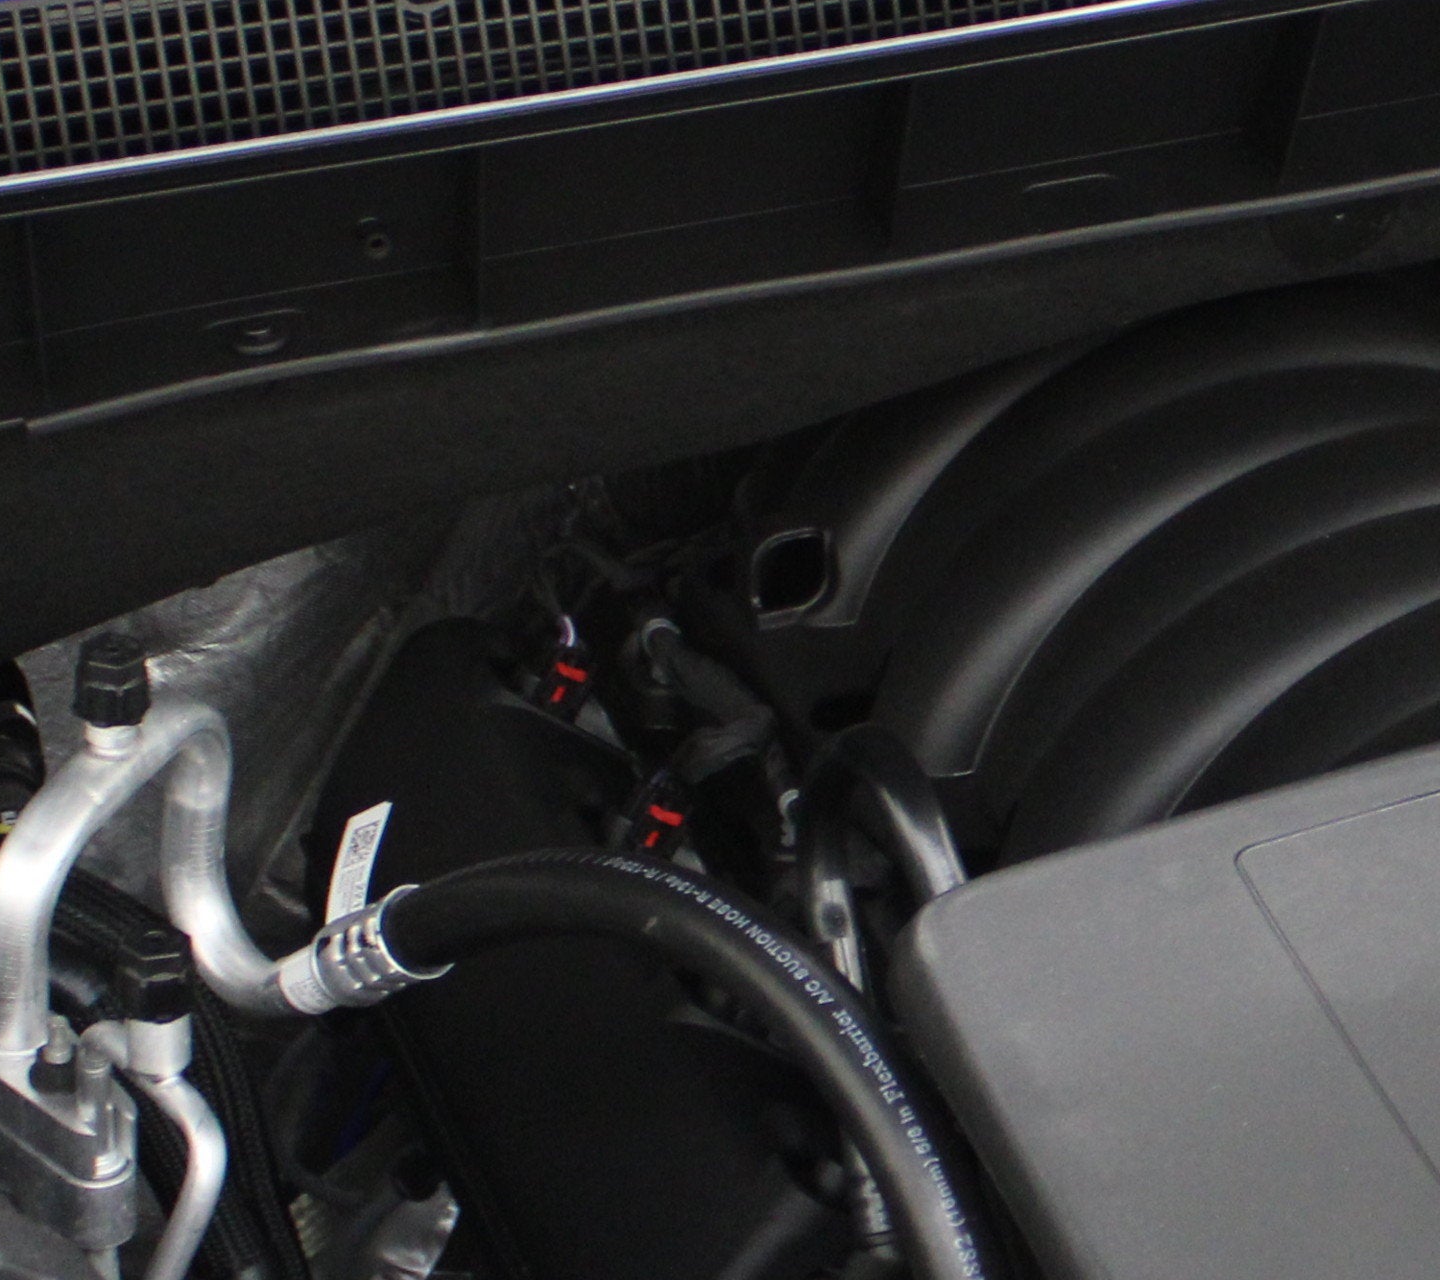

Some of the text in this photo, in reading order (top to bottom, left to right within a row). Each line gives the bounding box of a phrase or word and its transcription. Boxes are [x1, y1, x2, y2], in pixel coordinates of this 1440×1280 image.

[706, 897, 753, 929] HOSE
[745, 923, 810, 981] SUCTION
[831, 1008, 905, 1105] Flexbarrier
